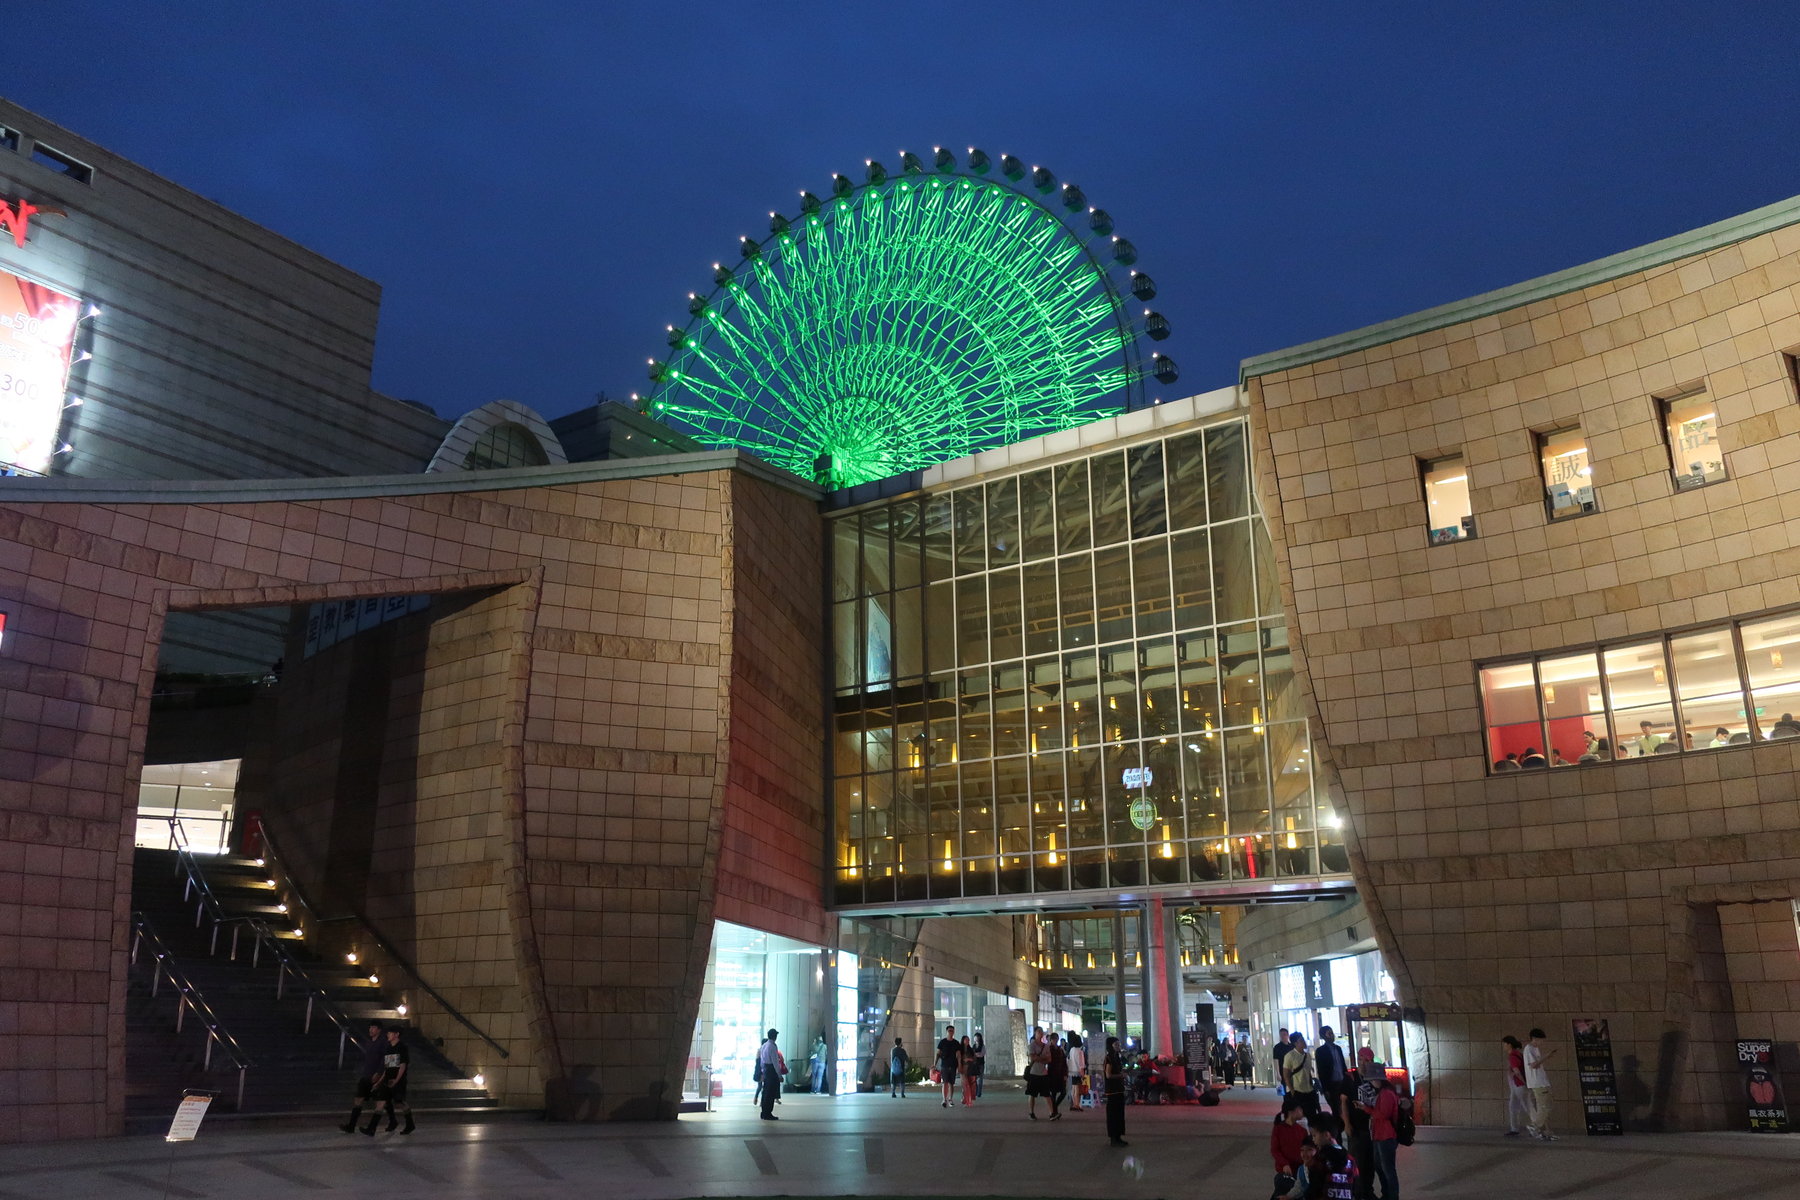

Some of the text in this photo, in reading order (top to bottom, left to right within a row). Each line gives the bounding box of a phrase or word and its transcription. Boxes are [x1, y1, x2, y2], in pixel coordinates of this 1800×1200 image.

[1551, 454, 1583, 485] 誠
[1737, 1042, 1771, 1055] Super
[1739, 1052, 1758, 1063] Dry
[1328, 1188, 1352, 1199] STAR
